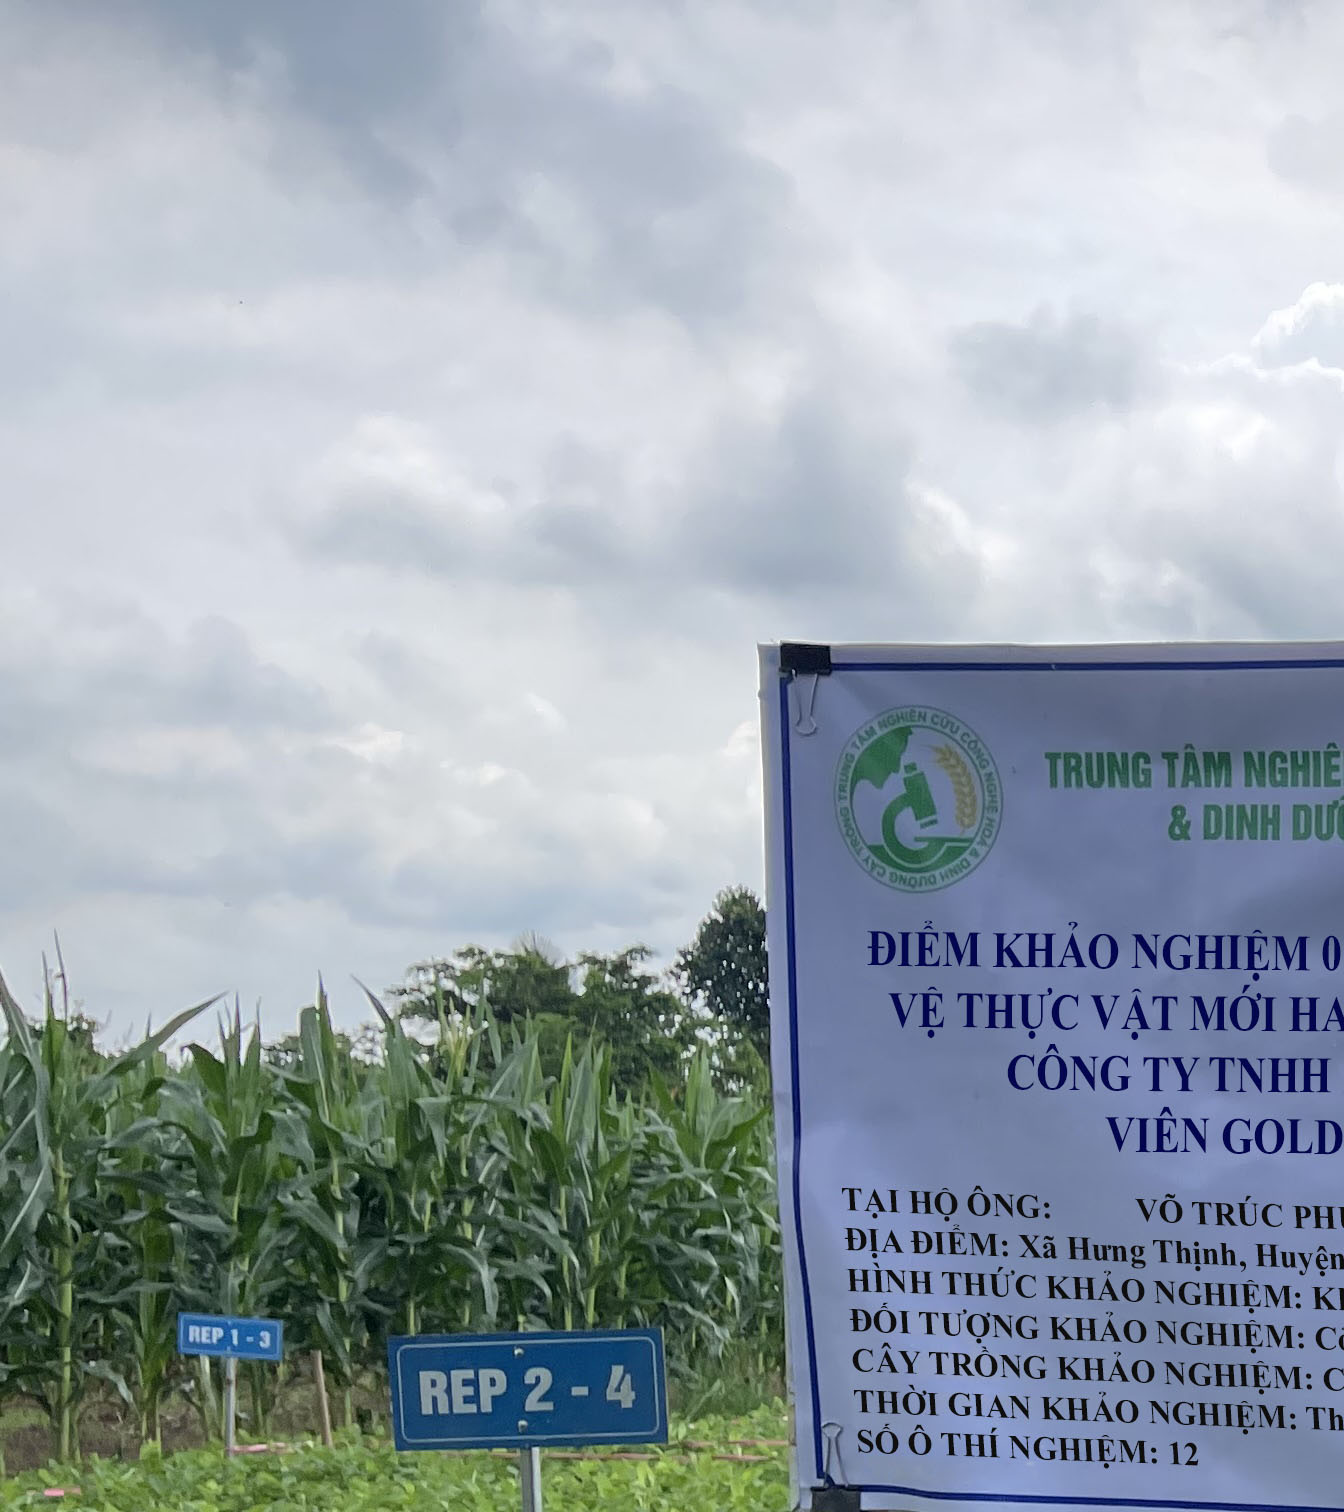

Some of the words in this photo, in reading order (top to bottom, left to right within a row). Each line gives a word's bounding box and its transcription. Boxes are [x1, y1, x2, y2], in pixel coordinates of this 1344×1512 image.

[1045, 751, 1152, 788] TRUNG
[1162, 743, 1232, 787] TÂM
[1168, 805, 1192, 841] &
[1203, 804, 1280, 840] DINH
[867, 920, 981, 967] ĐIỂM
[992, 921, 1119, 969] KHẢO
[1132, 929, 1310, 980] NGHIỆM
[889, 986, 944, 1038] VỆ
[957, 987, 1079, 1039] THỰC
[1090, 989, 1177, 1040] VẬT
[1189, 985, 1276, 1031] MỚI
[1007, 1043, 1132, 1091] CÔNG
[1143, 1057, 1200, 1091] TY
[1209, 1056, 1331, 1093] TNHH
[1105, 1106, 1209, 1153] VIÊN
[1222, 1117, 1343, 1155] GOLD
[841, 1188, 899, 1219] TẠI
[909, 1188, 958, 1222] HỘ
[967, 1186, 1050, 1219] ÔNG:
[1136, 1194, 1183, 1223] VÕ
[1192, 1196, 1283, 1227] TRÚC
[844, 1227, 904, 1258] ĐỊA
[911, 1224, 1008, 1257] ĐIỂM:
[1019, 1234, 1057, 1259] Xã
[1067, 1236, 1146, 1269] Hưng
[1153, 1240, 1247, 1272] Thịnh,
[848, 1262, 933, 1294] HÌNH
[942, 1267, 1037, 1298] THỨC
[1045, 1271, 1145, 1302] KHẢO
[1154, 1280, 1302, 1314] NGHIỆM:
[189, 1325, 224, 1344] REP
[231, 1329, 238, 1346] 1
[259, 1331, 270, 1348] 3
[850, 1303, 909, 1334] ĐỐI
[919, 1309, 1039, 1344] TƯỢNG
[1050, 1312, 1147, 1343] KHẢO
[1156, 1320, 1304, 1354] NGHIỆM:
[419, 1368, 507, 1415] REP
[523, 1367, 554, 1412] 2
[571, 1386, 589, 1396] -
[606, 1365, 636, 1409] 4
[852, 1342, 920, 1374] CÂY
[928, 1347, 1048, 1380] TRỒNG
[1058, 1352, 1155, 1384] KHẢO
[1164, 1361, 1313, 1395] NGHIỆM:
[854, 1385, 939, 1416] THỜI
[948, 1392, 1031, 1419] GIAN
[1042, 1392, 1138, 1423] KHẢO
[1149, 1401, 1296, 1435] NGHIỆM:
[857, 1424, 898, 1455] SỐ
[908, 1425, 932, 1455] Ô
[941, 1428, 1000, 1458] THÍ
[1010, 1435, 1158, 1469] NGHIỆM:
[1170, 1442, 1199, 1466] 12
